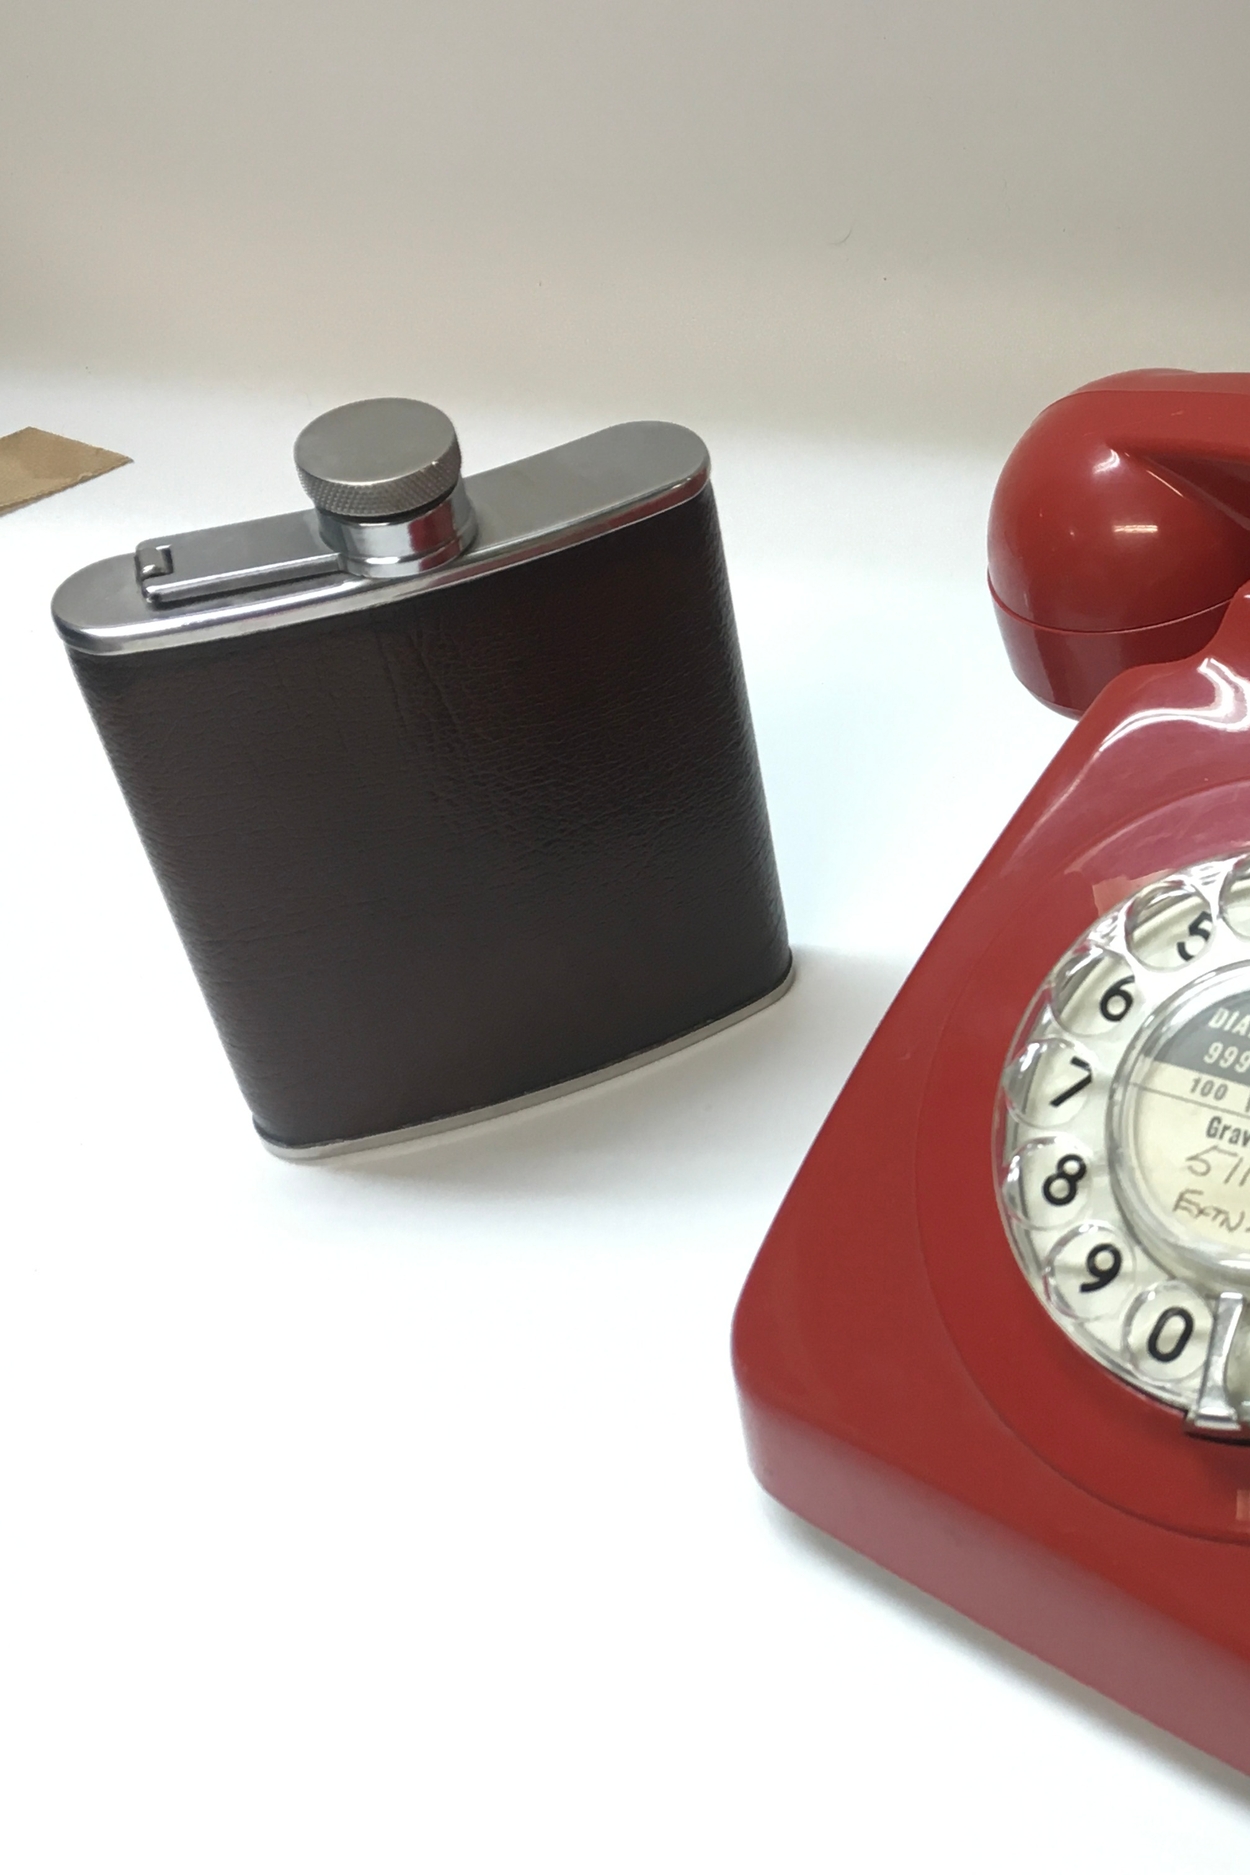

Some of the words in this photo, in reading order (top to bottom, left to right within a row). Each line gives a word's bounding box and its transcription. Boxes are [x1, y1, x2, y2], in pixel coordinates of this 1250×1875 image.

[1177, 912, 1212, 962] 5
[1099, 975, 1137, 1022] 6
[1050, 1056, 1092, 1109] 7
[1190, 1077, 1228, 1101] 100
[1043, 1154, 1086, 1206] 8
[1080, 1243, 1122, 1293] 9
[1148, 1307, 1194, 1363] 0
